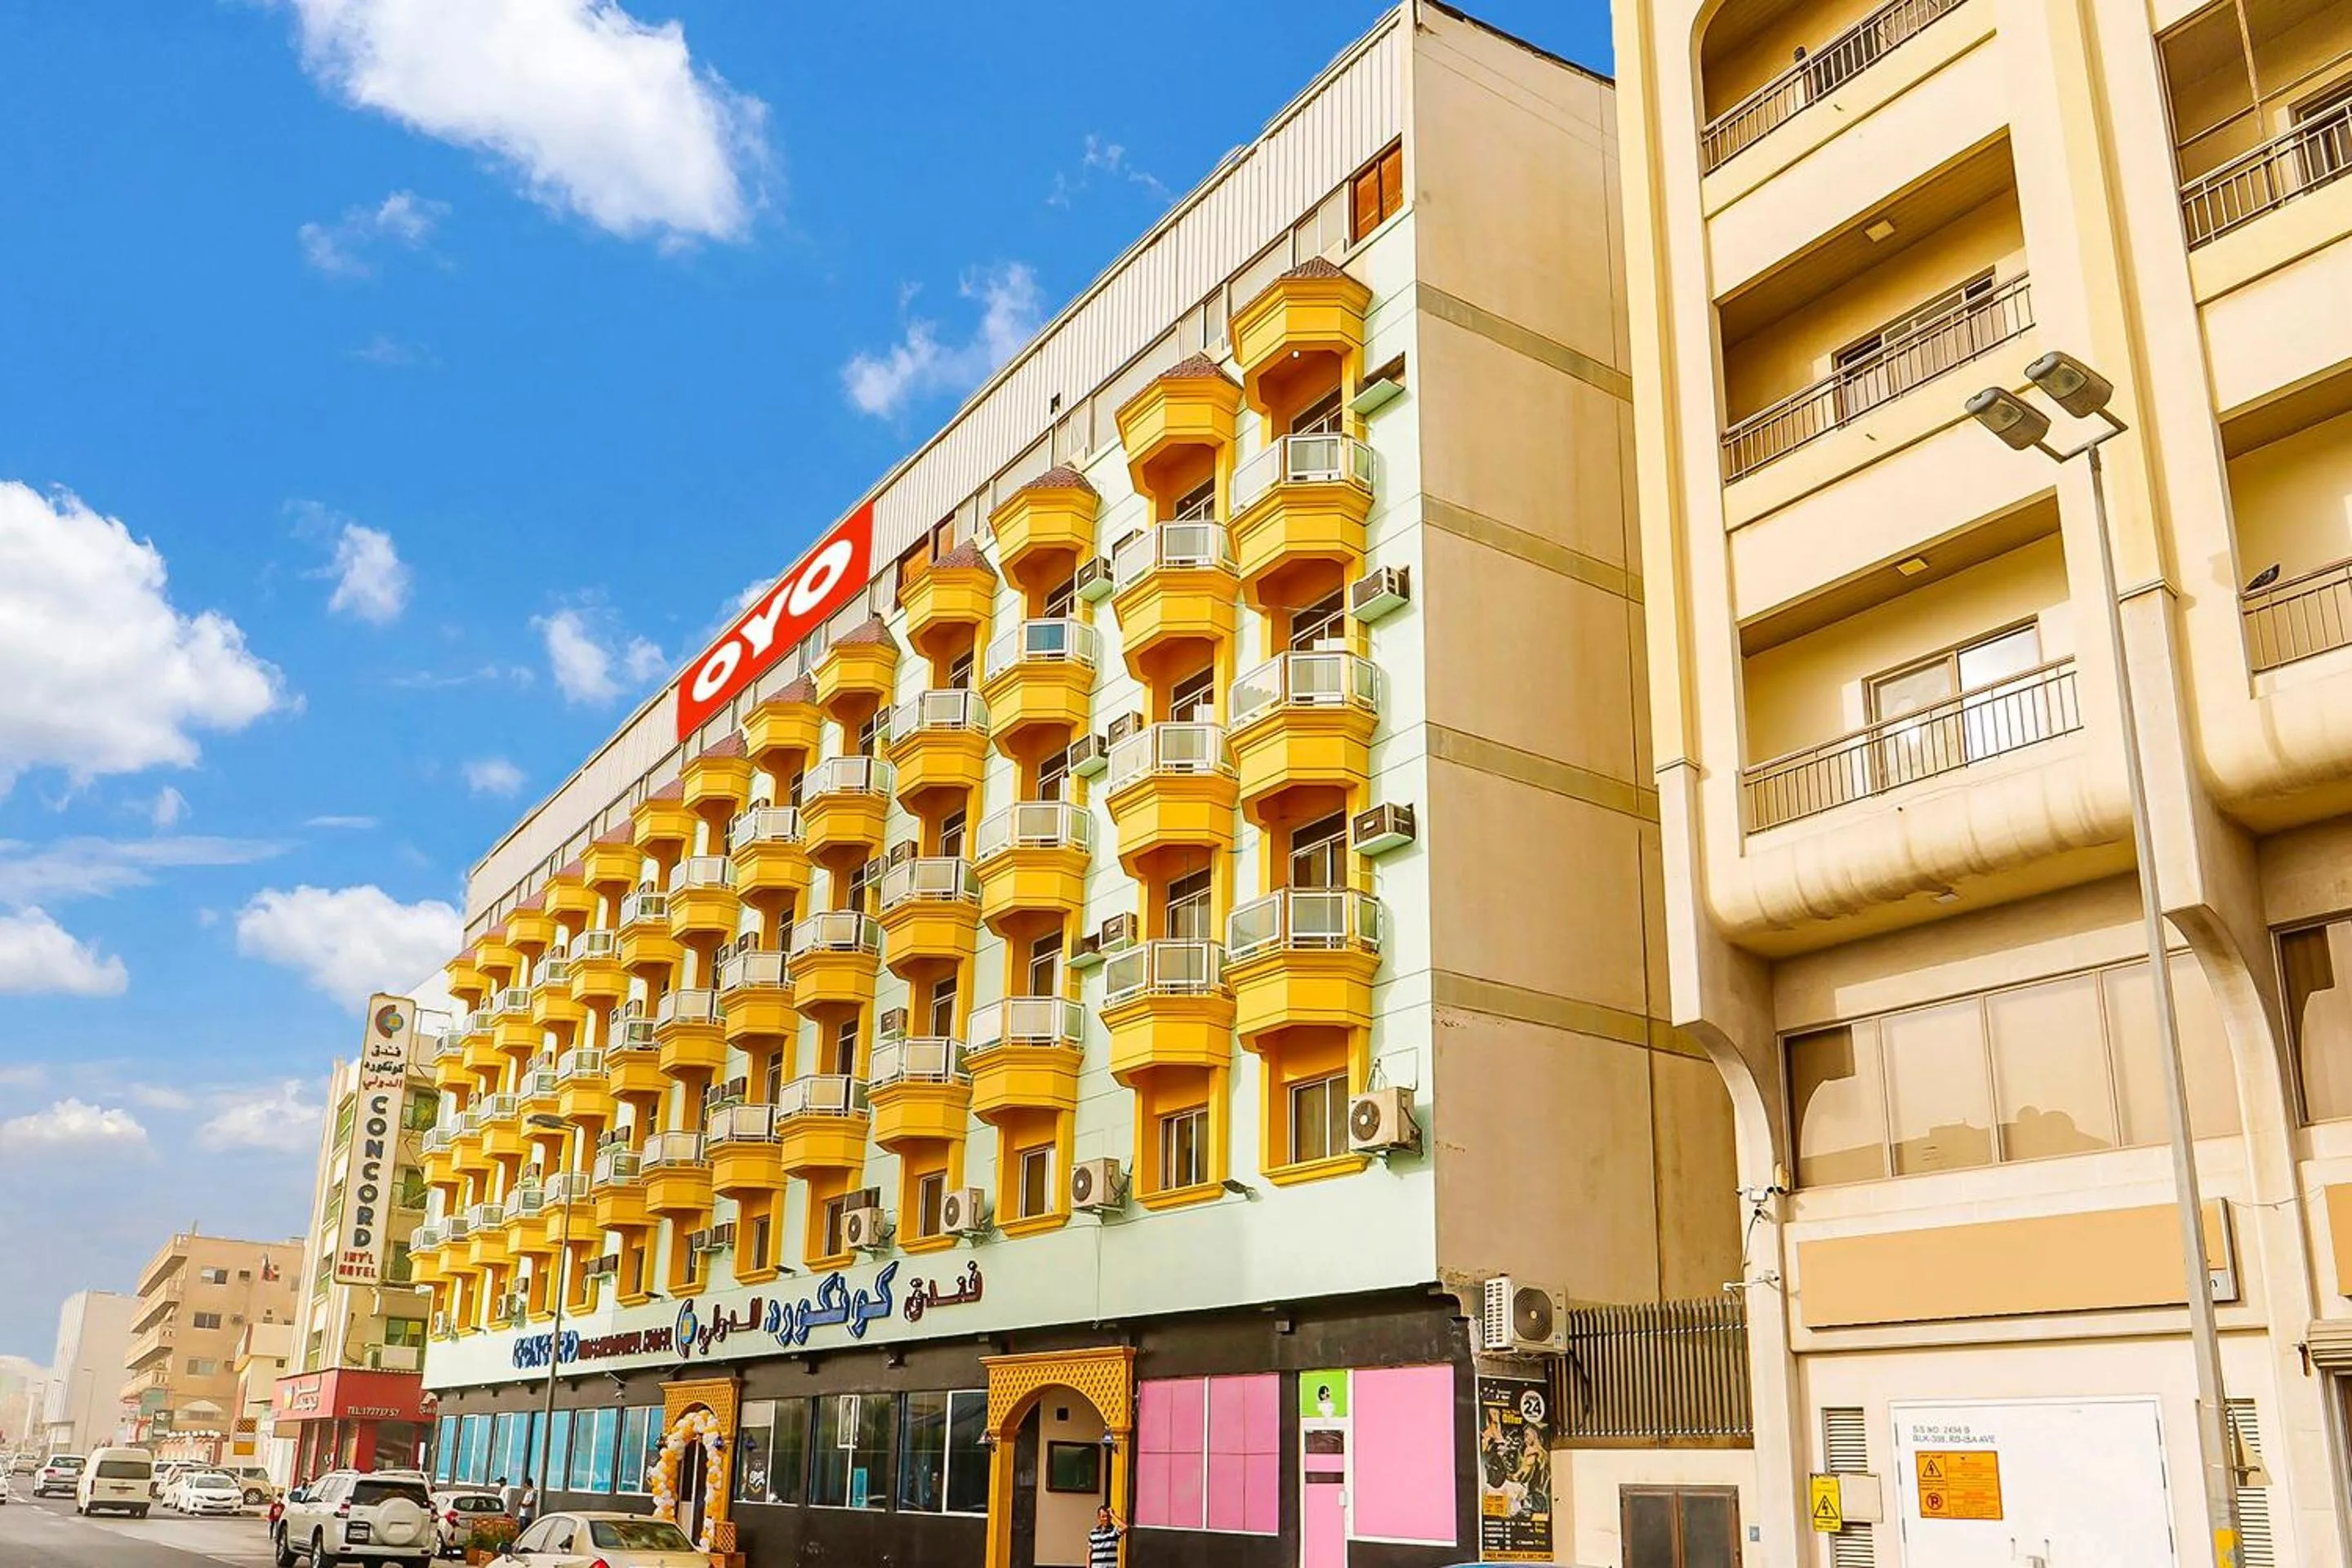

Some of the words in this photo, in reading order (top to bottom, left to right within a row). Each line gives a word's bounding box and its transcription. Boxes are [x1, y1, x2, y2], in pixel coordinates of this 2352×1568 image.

[693, 538, 853, 702] OYO
[371, 1045, 402, 1058] فندق
[353, 1096, 390, 1248] CONCORD
[338, 1263, 377, 1279] HOTEL
[903, 1259, 983, 1323] فندق
[1523, 1399, 1542, 1415] 24
